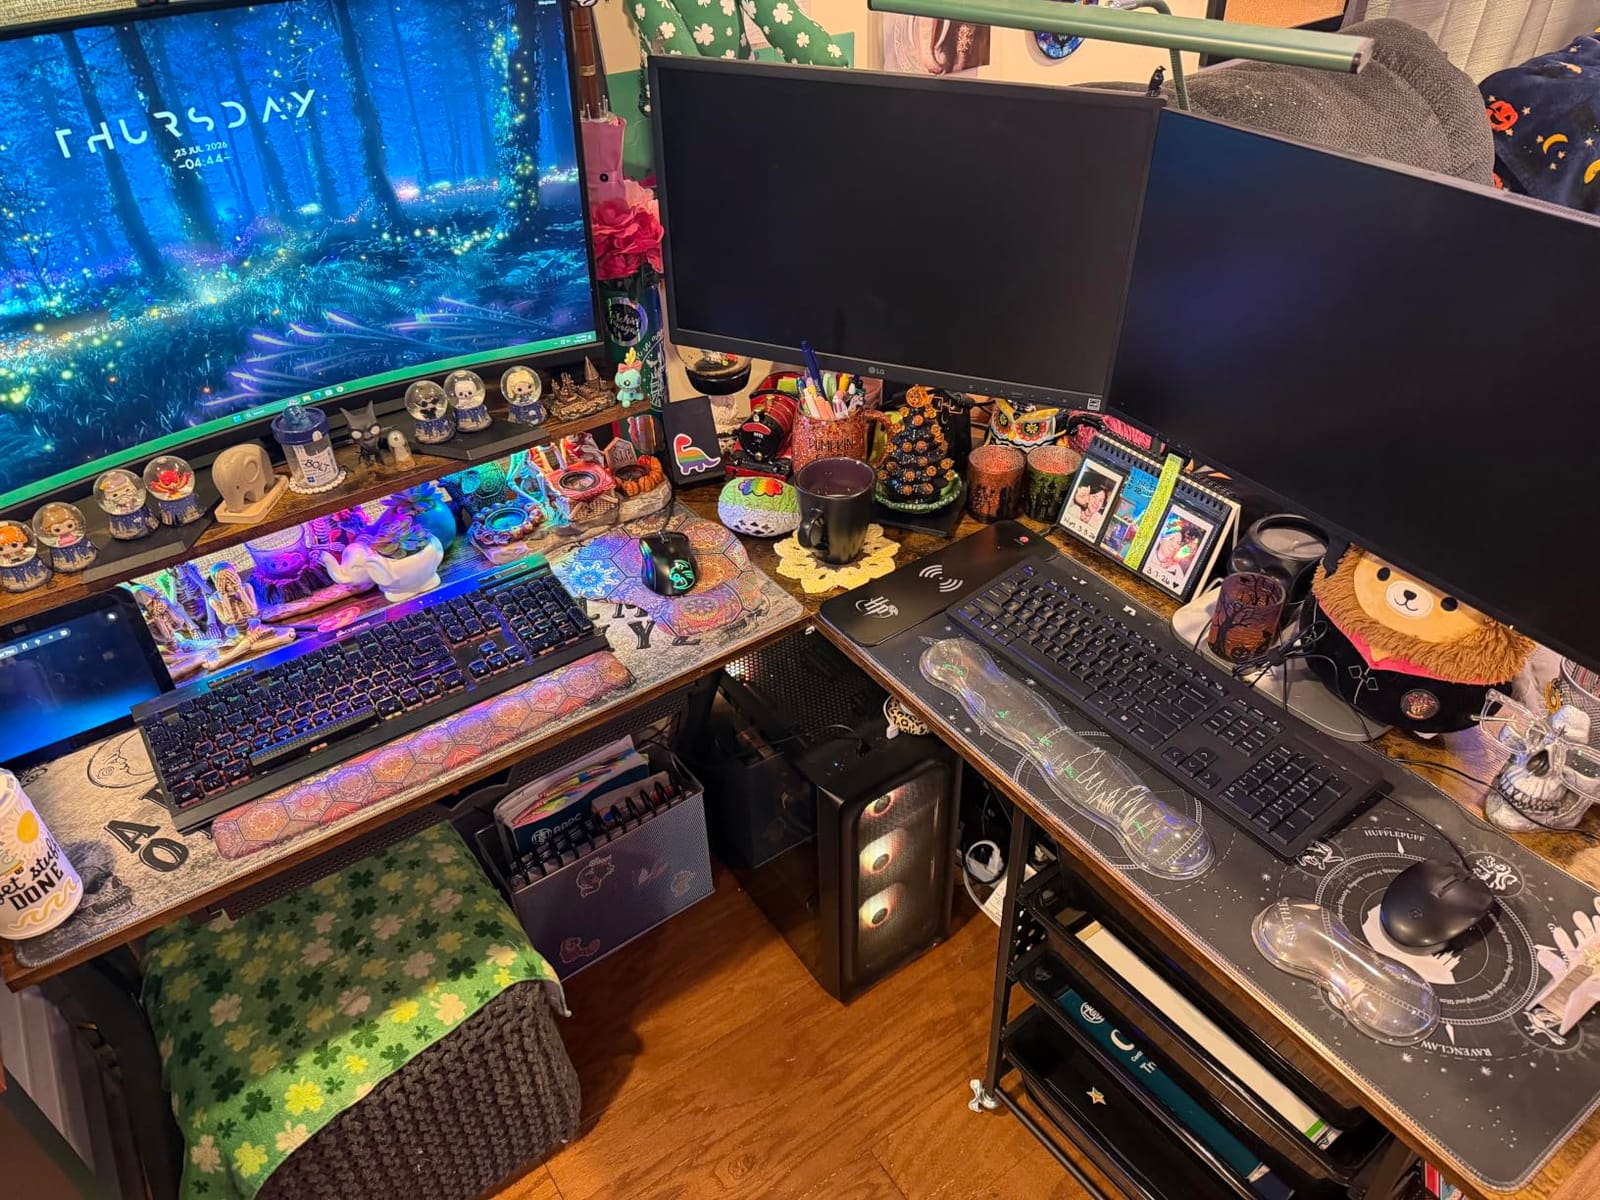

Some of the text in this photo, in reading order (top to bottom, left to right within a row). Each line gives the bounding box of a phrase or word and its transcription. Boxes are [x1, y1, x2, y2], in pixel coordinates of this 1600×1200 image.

[55, 89, 315, 158] THURSDAY
[174, 141, 228, 158] 23 JUL 2026
[628, 621, 655, 649] Y
[104, 820, 161, 853] A
[1364, 829, 1425, 841] HUFFLEPUFF
[139, 837, 189, 872] O
[8, 860, 64, 911] DONE
[1420, 1040, 1493, 1057] RAVENCLAW
